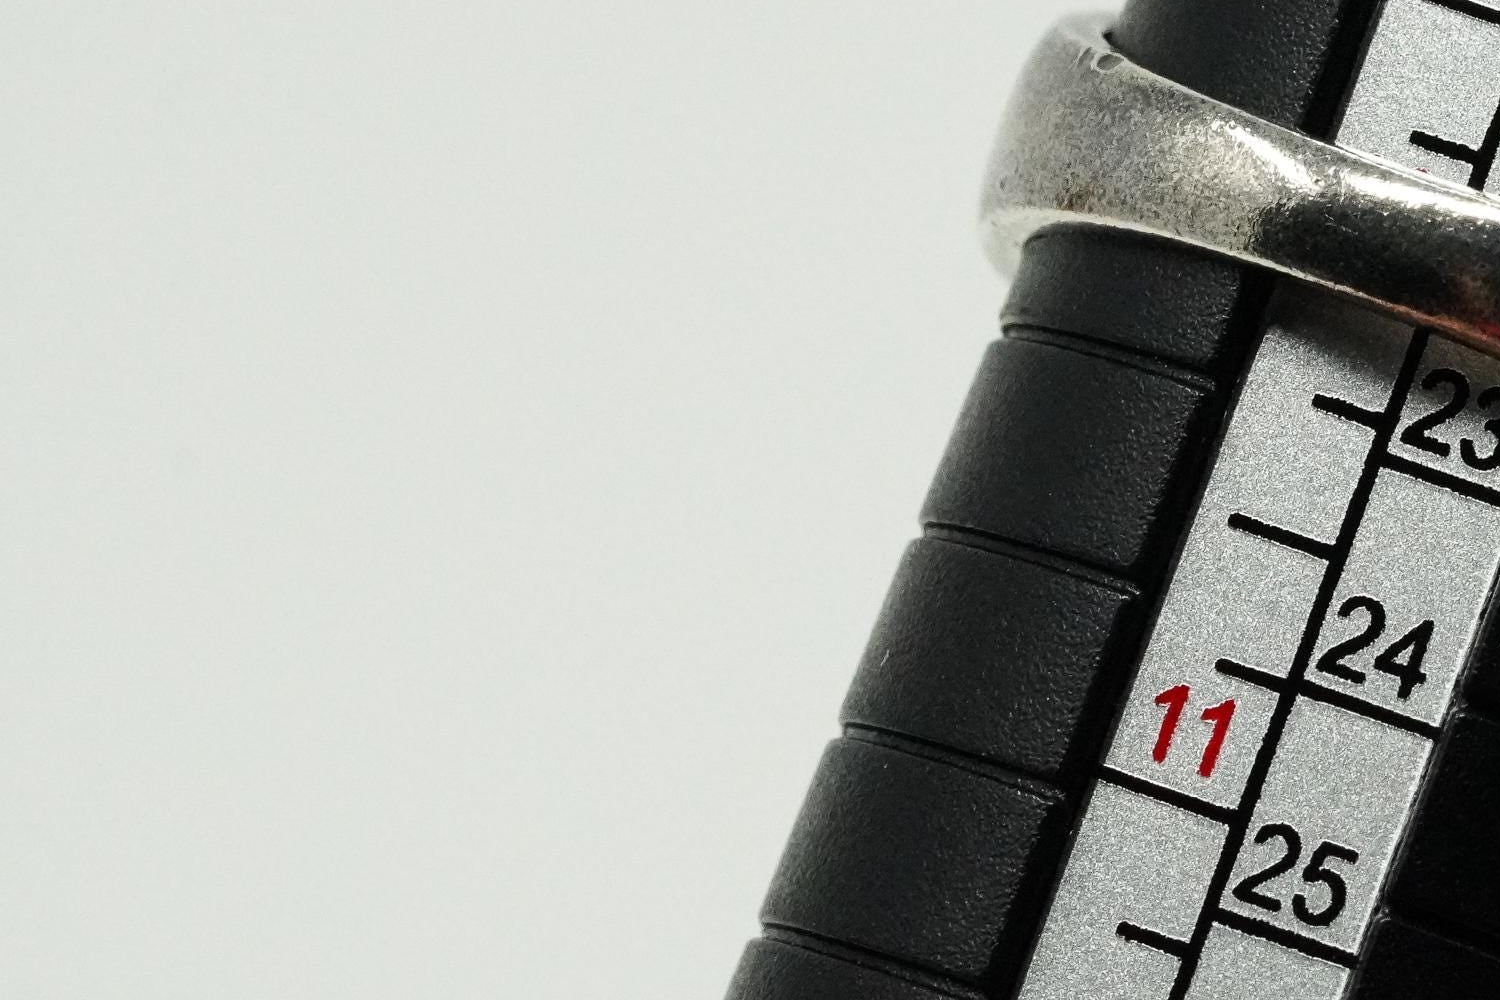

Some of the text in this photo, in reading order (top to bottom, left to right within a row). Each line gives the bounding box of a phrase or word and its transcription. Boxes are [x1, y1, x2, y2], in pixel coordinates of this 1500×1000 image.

[1316, 596, 1434, 702] 24
[1152, 685, 1236, 778] 11
[1232, 822, 1359, 929] 25
